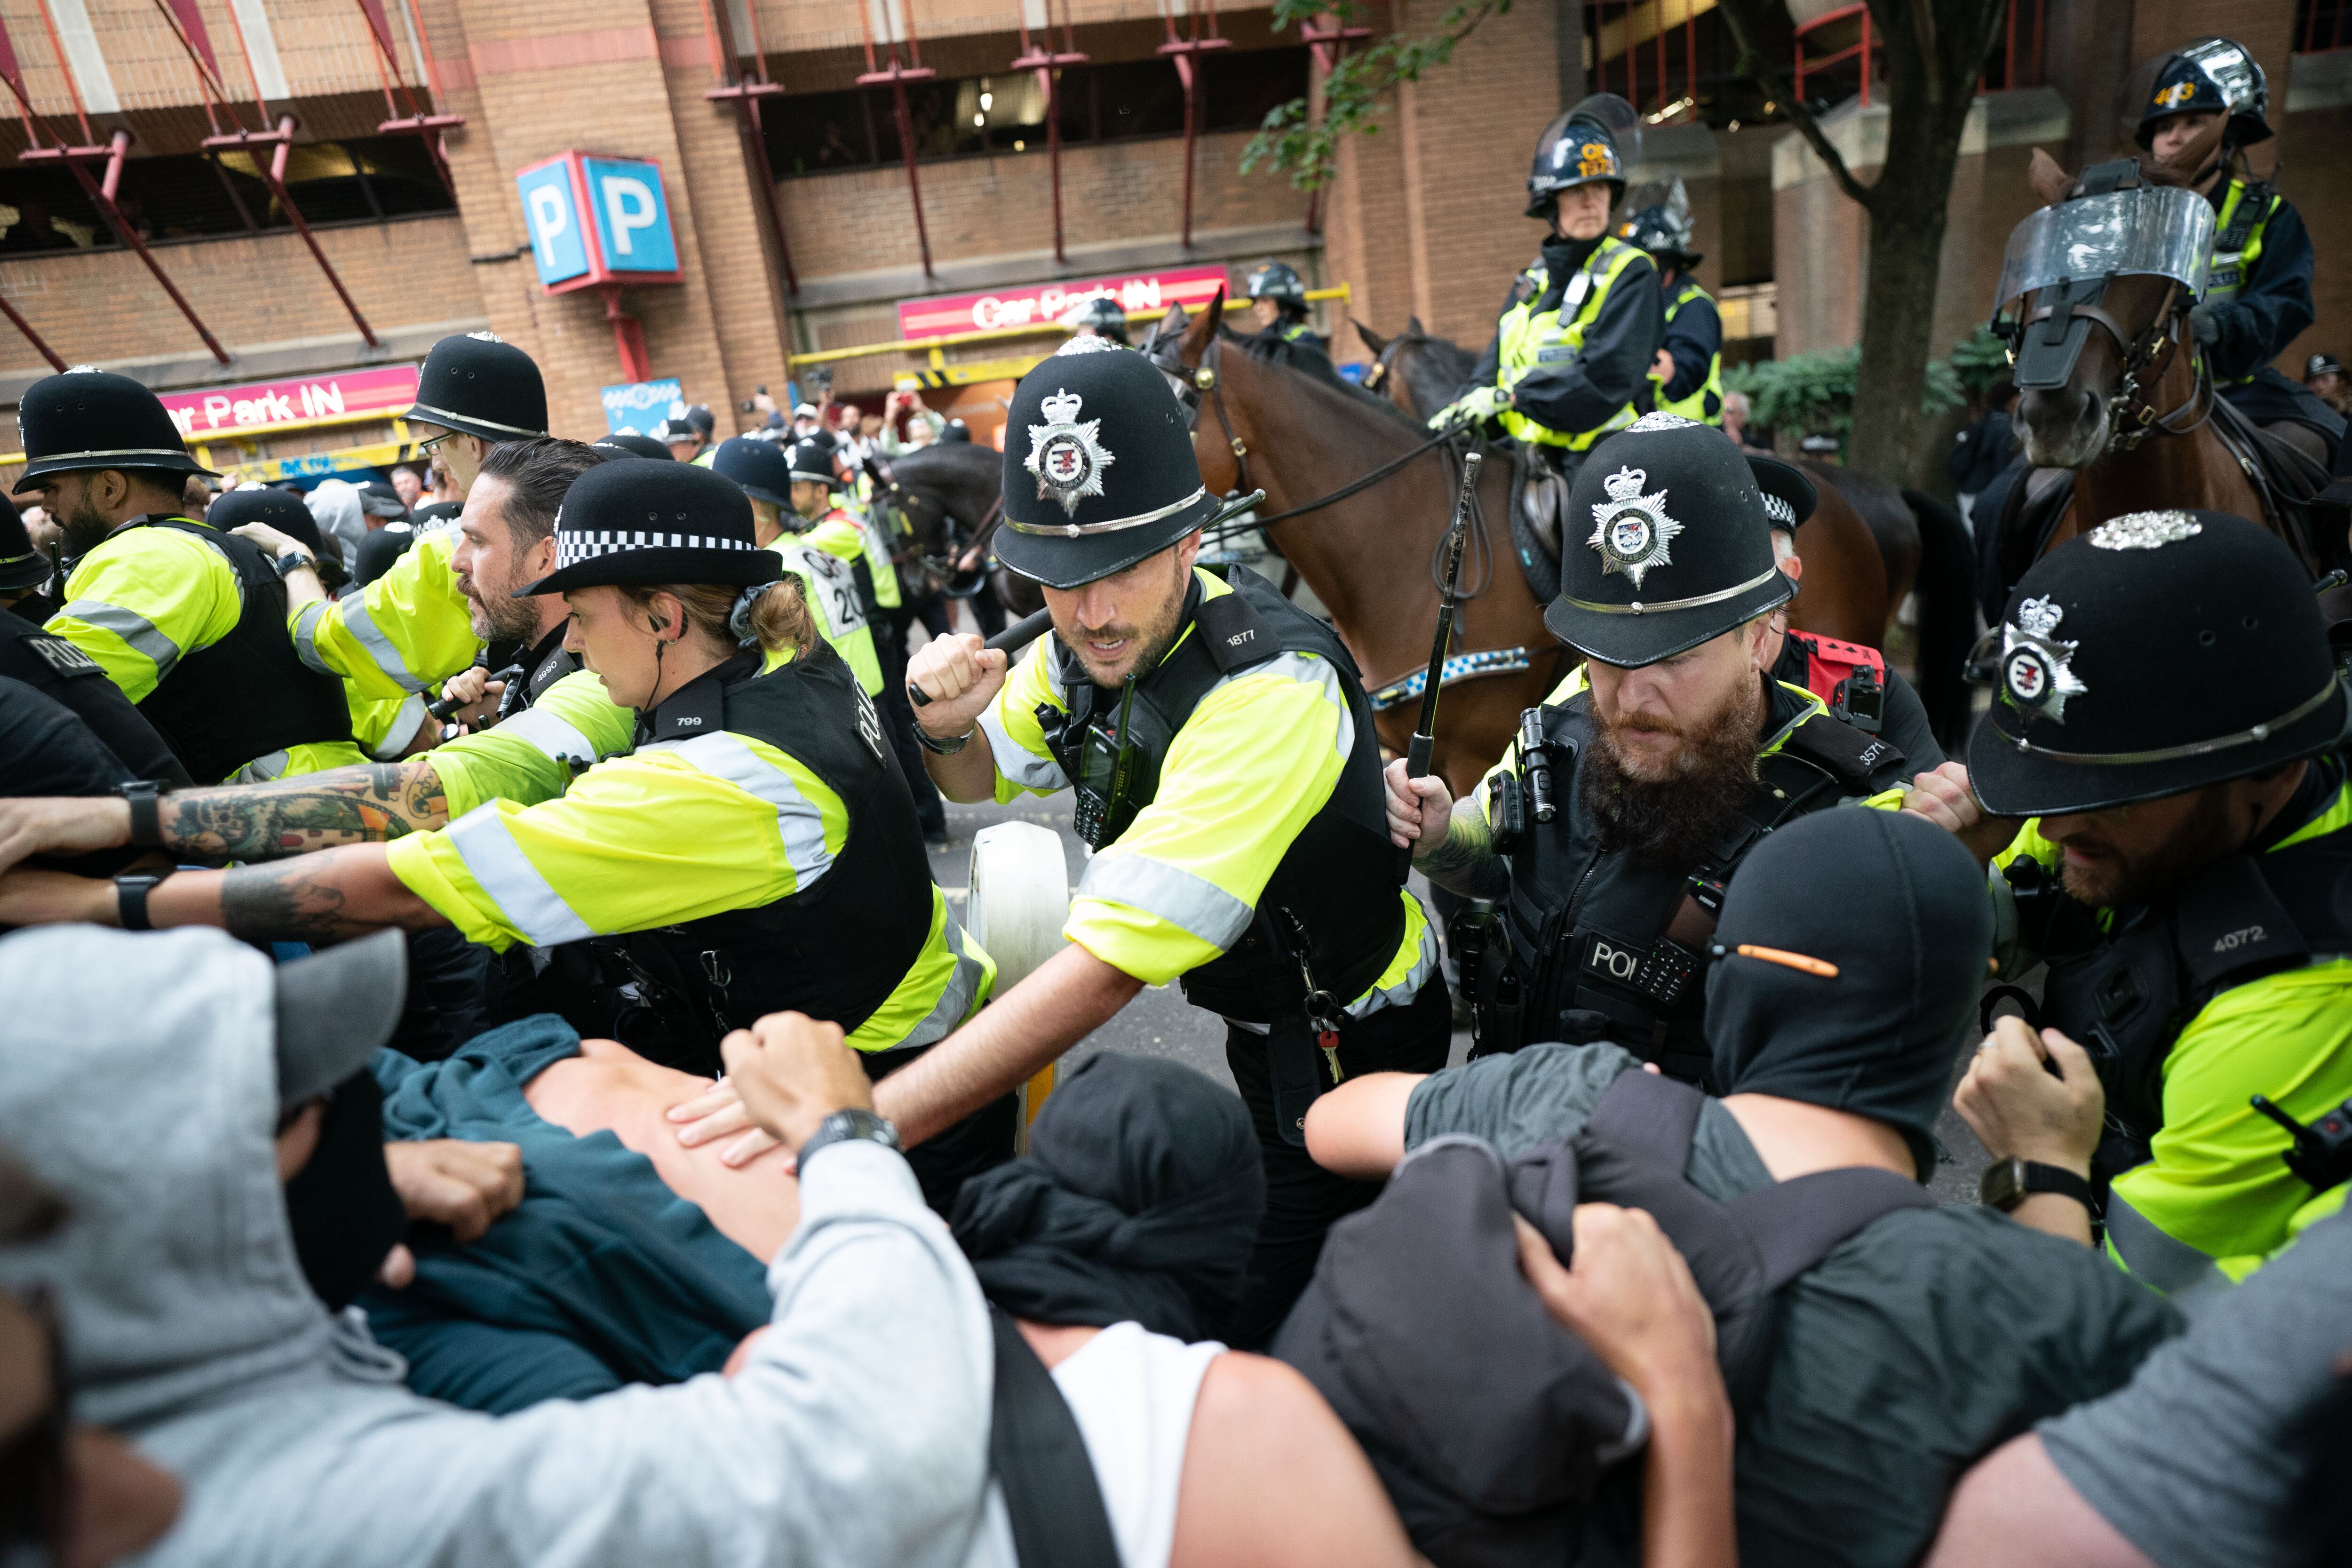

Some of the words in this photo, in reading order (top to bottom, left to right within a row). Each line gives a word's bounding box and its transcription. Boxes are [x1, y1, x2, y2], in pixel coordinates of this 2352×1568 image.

[529, 183, 566, 267] P
[600, 175, 657, 255] P
[972, 296, 1036, 329] Car
[1122, 278, 1161, 310] IN
[203, 389, 296, 429] Park
[299, 381, 345, 418] IN
[1226, 629, 1255, 647] 1877
[538, 661, 557, 682] 4990
[677, 717, 702, 726] 799
[1859, 742, 1885, 766] 3571
[2213, 925, 2268, 952] 4072
